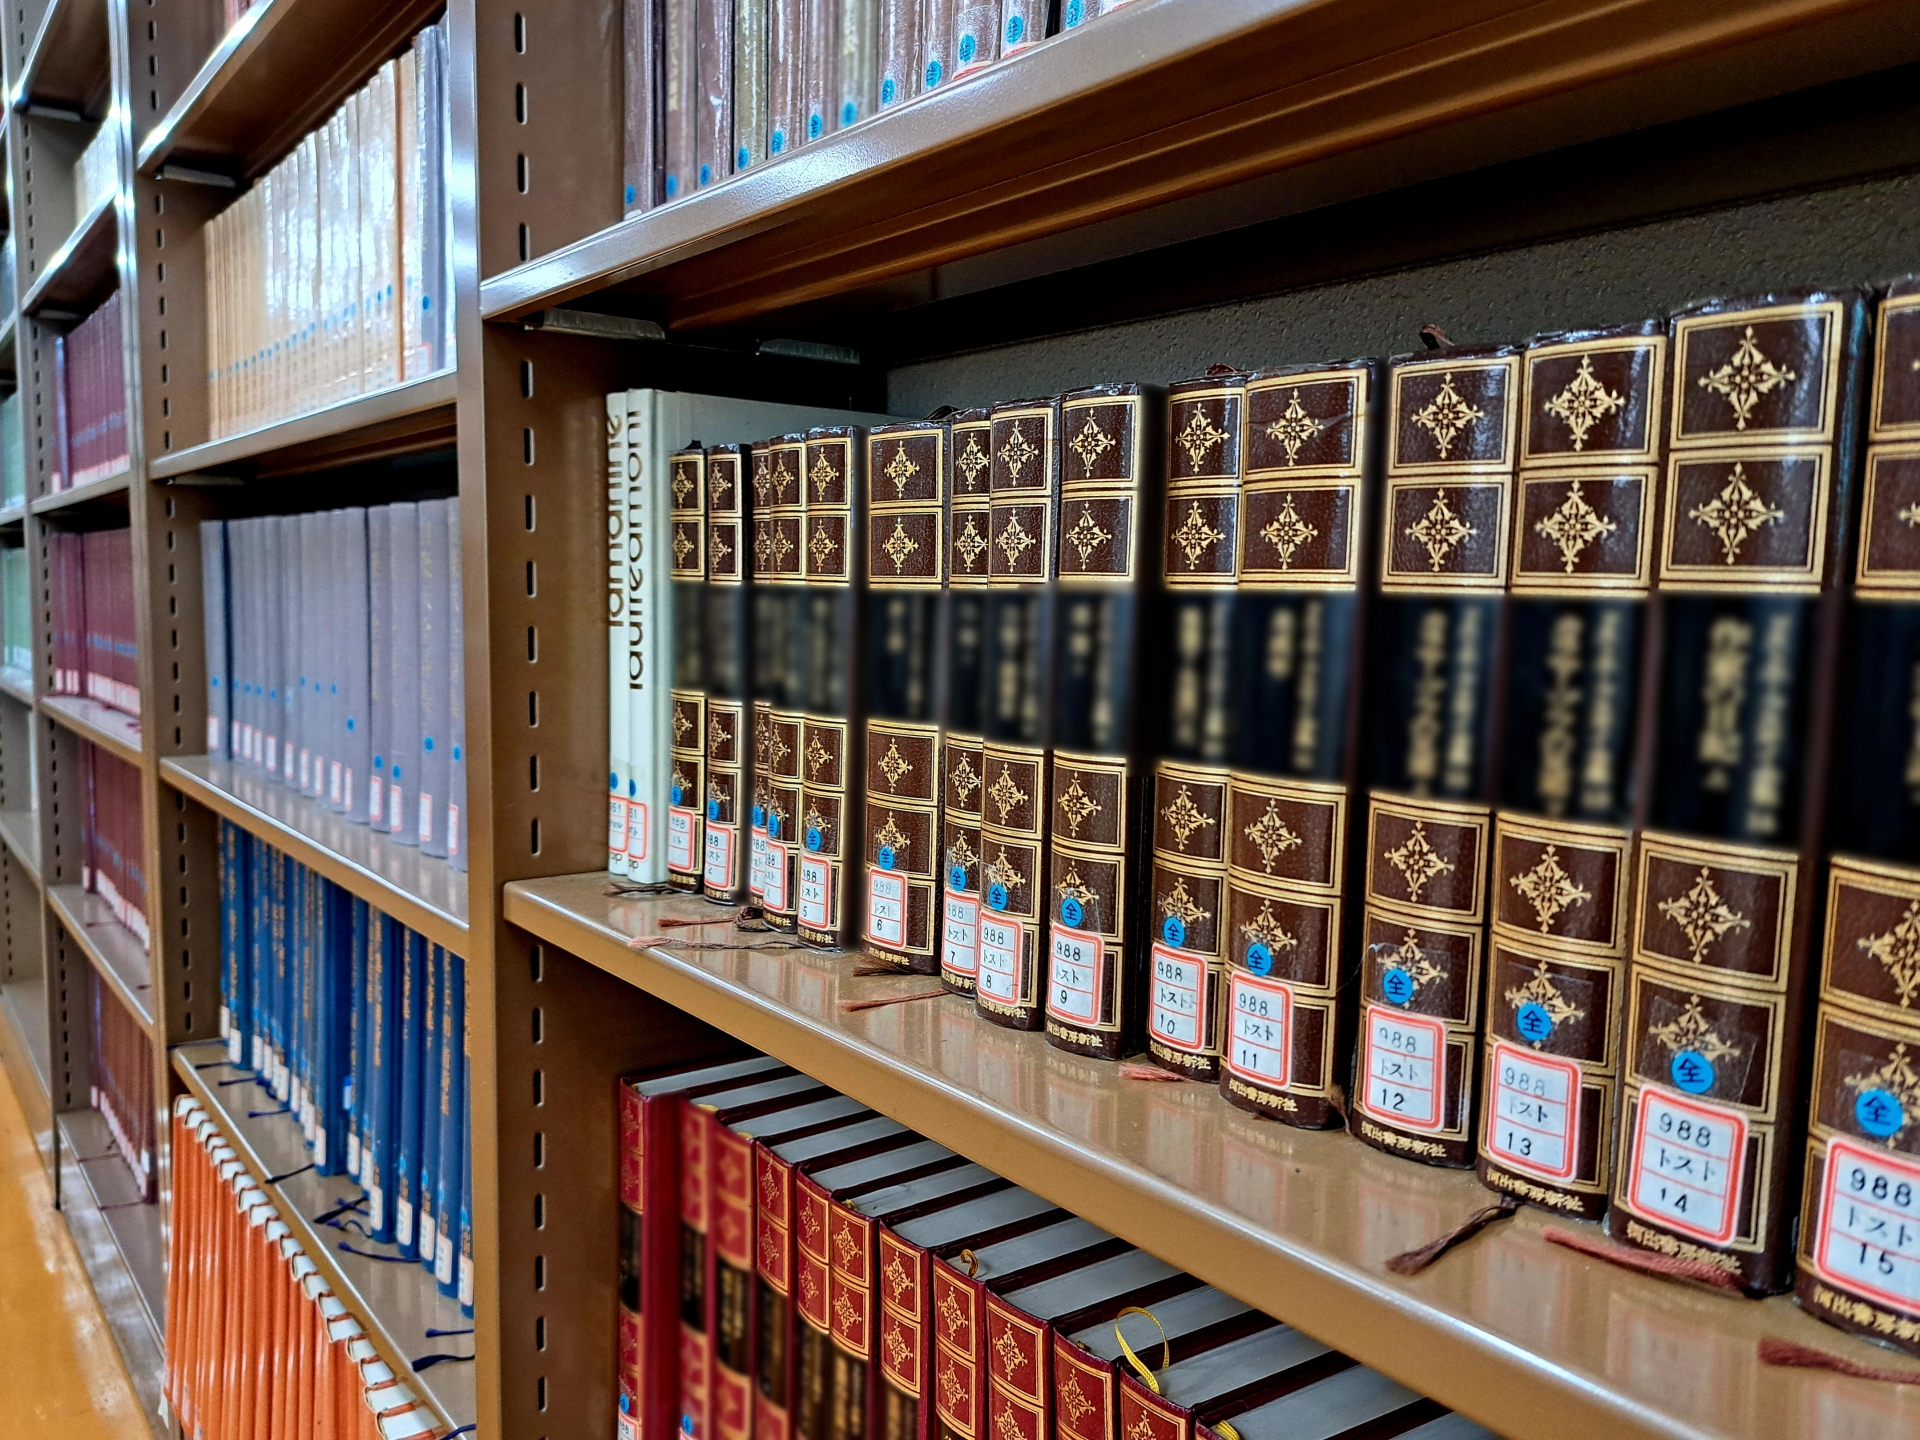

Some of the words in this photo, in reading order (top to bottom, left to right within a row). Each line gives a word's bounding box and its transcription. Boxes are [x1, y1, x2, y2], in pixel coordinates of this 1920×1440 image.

[881, 849, 892, 865] 全
[873, 879, 891, 895] 988
[952, 870, 962, 886] 全
[992, 887, 1005, 904] 全
[802, 905, 808, 918] 5
[947, 903, 964, 920] 988
[1064, 901, 1080, 921] 全
[877, 918, 883, 932] 6
[983, 926, 1005, 946] 988
[1166, 922, 1181, 943] 全
[950, 950, 956, 964] 7
[1056, 940, 1082, 962] 988
[1248, 949, 1265, 971] 全
[986, 974, 992, 989] 8
[1157, 960, 1184, 983] 988
[1387, 973, 1405, 996] 全
[1060, 989, 1068, 1004] 9
[1238, 992, 1269, 1017] 988
[1159, 1013, 1176, 1035] 10
[1522, 1009, 1544, 1035] 全
[1378, 1026, 1417, 1054] 988
[1241, 1049, 1258, 1070] 11
[1676, 1056, 1705, 1085] 全
[1503, 1066, 1547, 1098] 988
[1380, 1088, 1405, 1113] 12
[1861, 1094, 1893, 1128] 全
[1658, 1112, 1712, 1149] 988
[1507, 1131, 1533, 1157] 13
[1849, 1166, 1913, 1209] 988
[1659, 1186, 1690, 1214] 14
